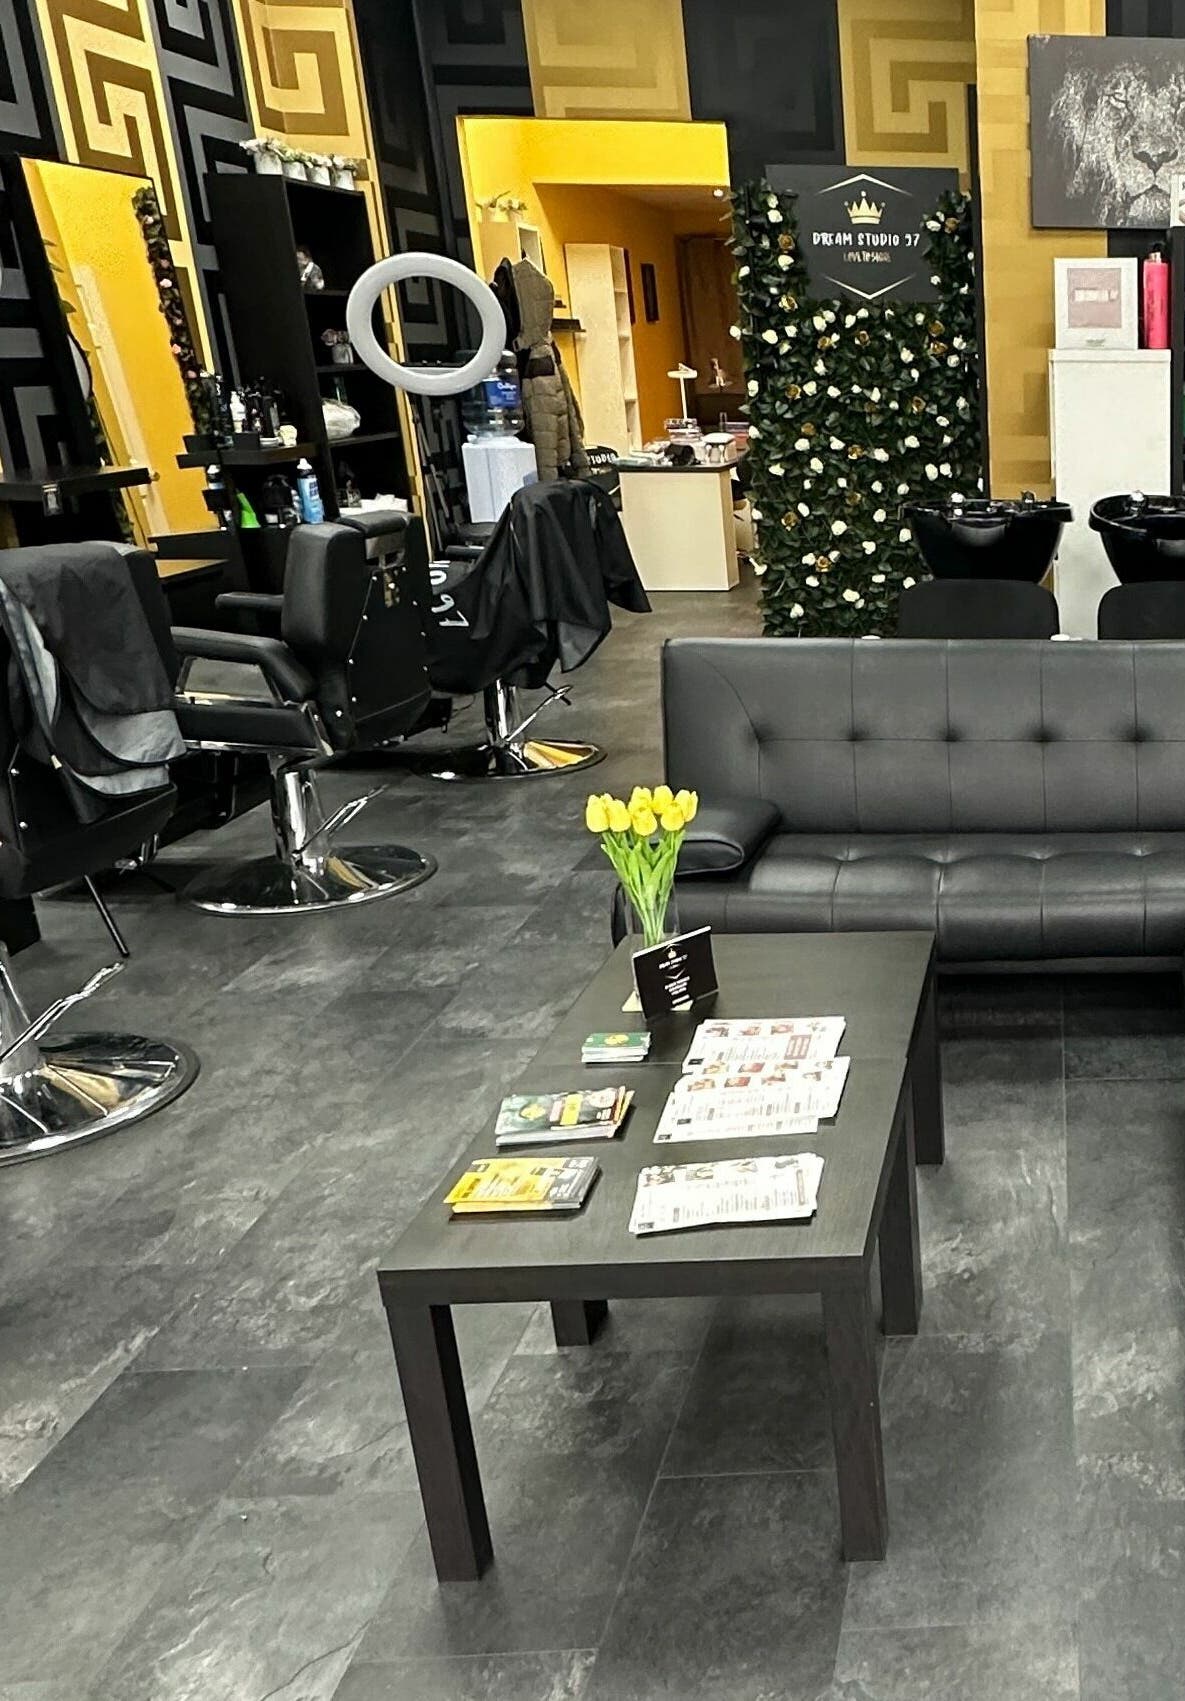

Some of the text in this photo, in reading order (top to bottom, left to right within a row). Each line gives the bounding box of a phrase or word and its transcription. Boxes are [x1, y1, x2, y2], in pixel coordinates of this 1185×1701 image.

[812, 231, 853, 247] DREAM
[857, 231, 900, 247] STUDIO
[587, 453, 617, 465] TUDIO
[431, 594, 470, 627] 97
